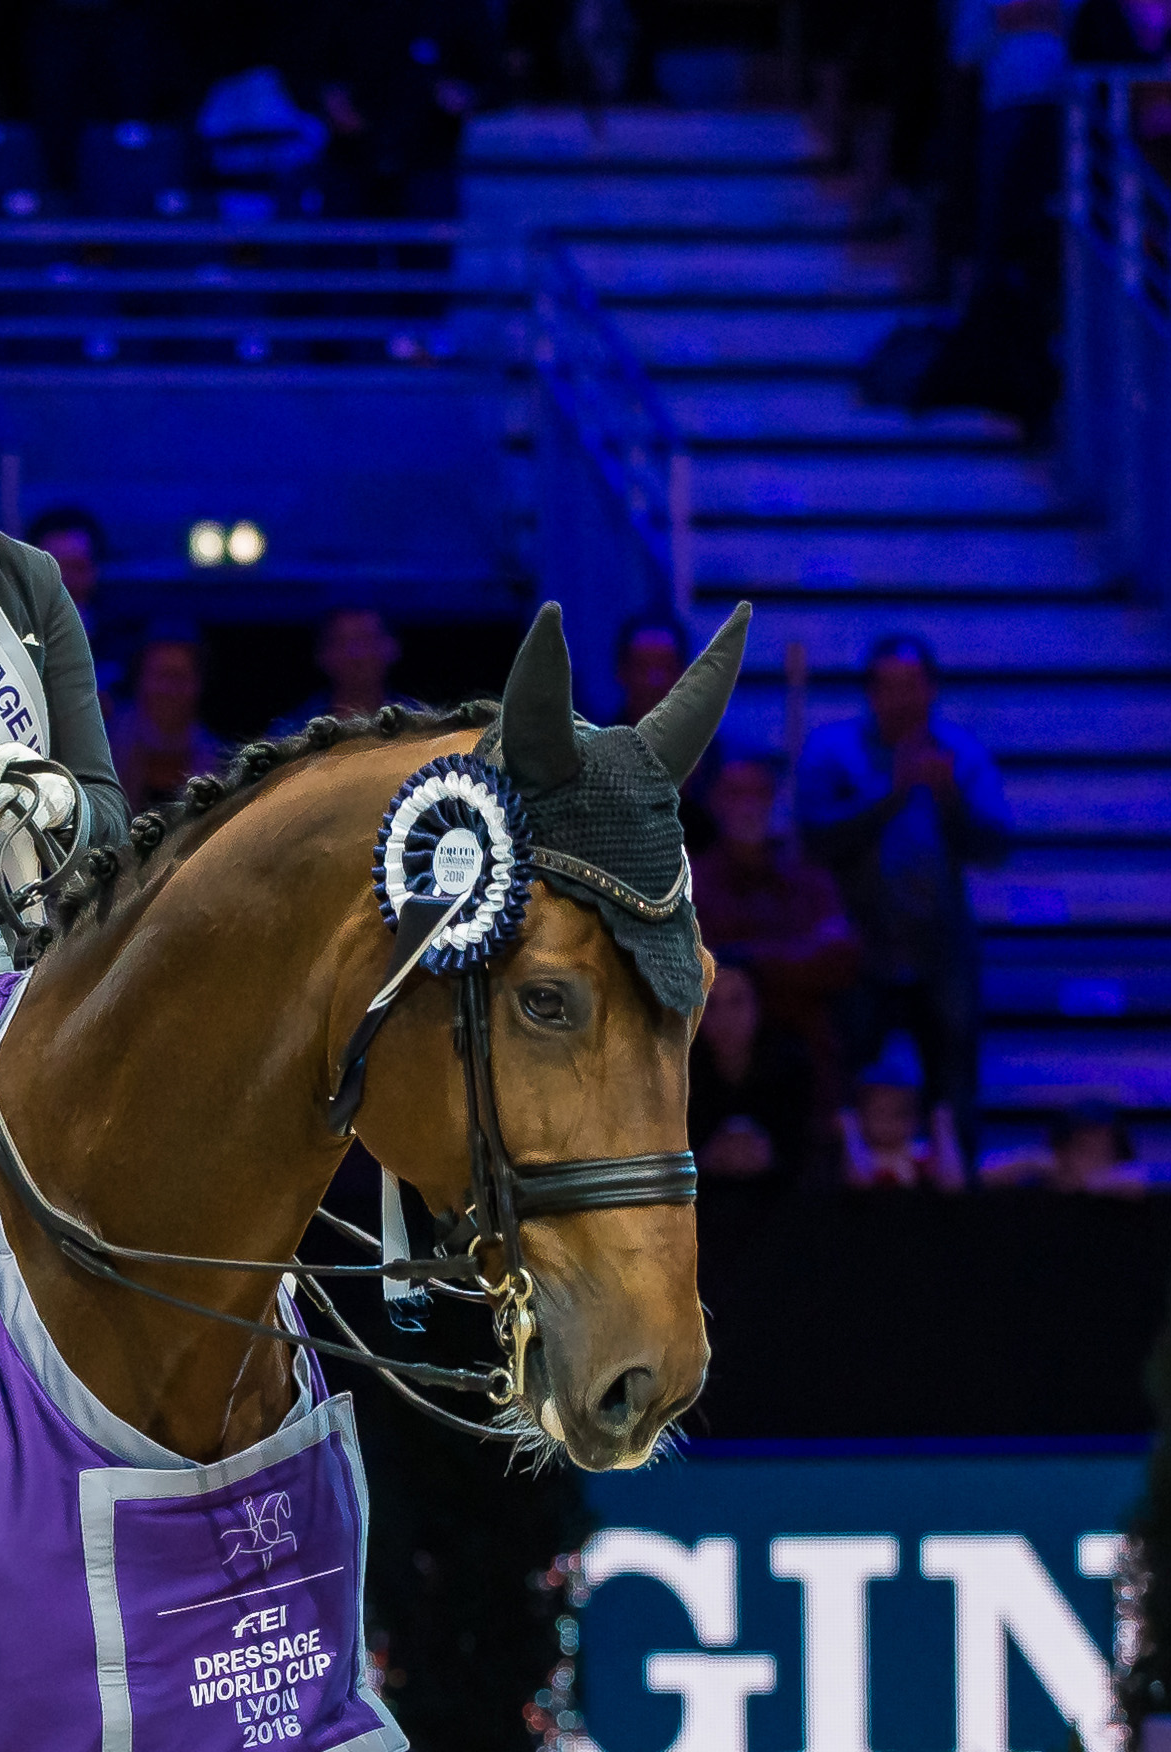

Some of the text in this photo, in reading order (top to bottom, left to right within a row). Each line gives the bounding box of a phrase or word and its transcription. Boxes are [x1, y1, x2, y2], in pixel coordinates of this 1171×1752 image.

[443, 870, 465, 883] 2018
[232, 1605, 288, 1638] FEI
[194, 1628, 322, 1681] DRESSAGE
[190, 1667, 281, 1707] WORLD
[235, 1687, 299, 1724] LYON
[243, 1714, 302, 1749] 2018
